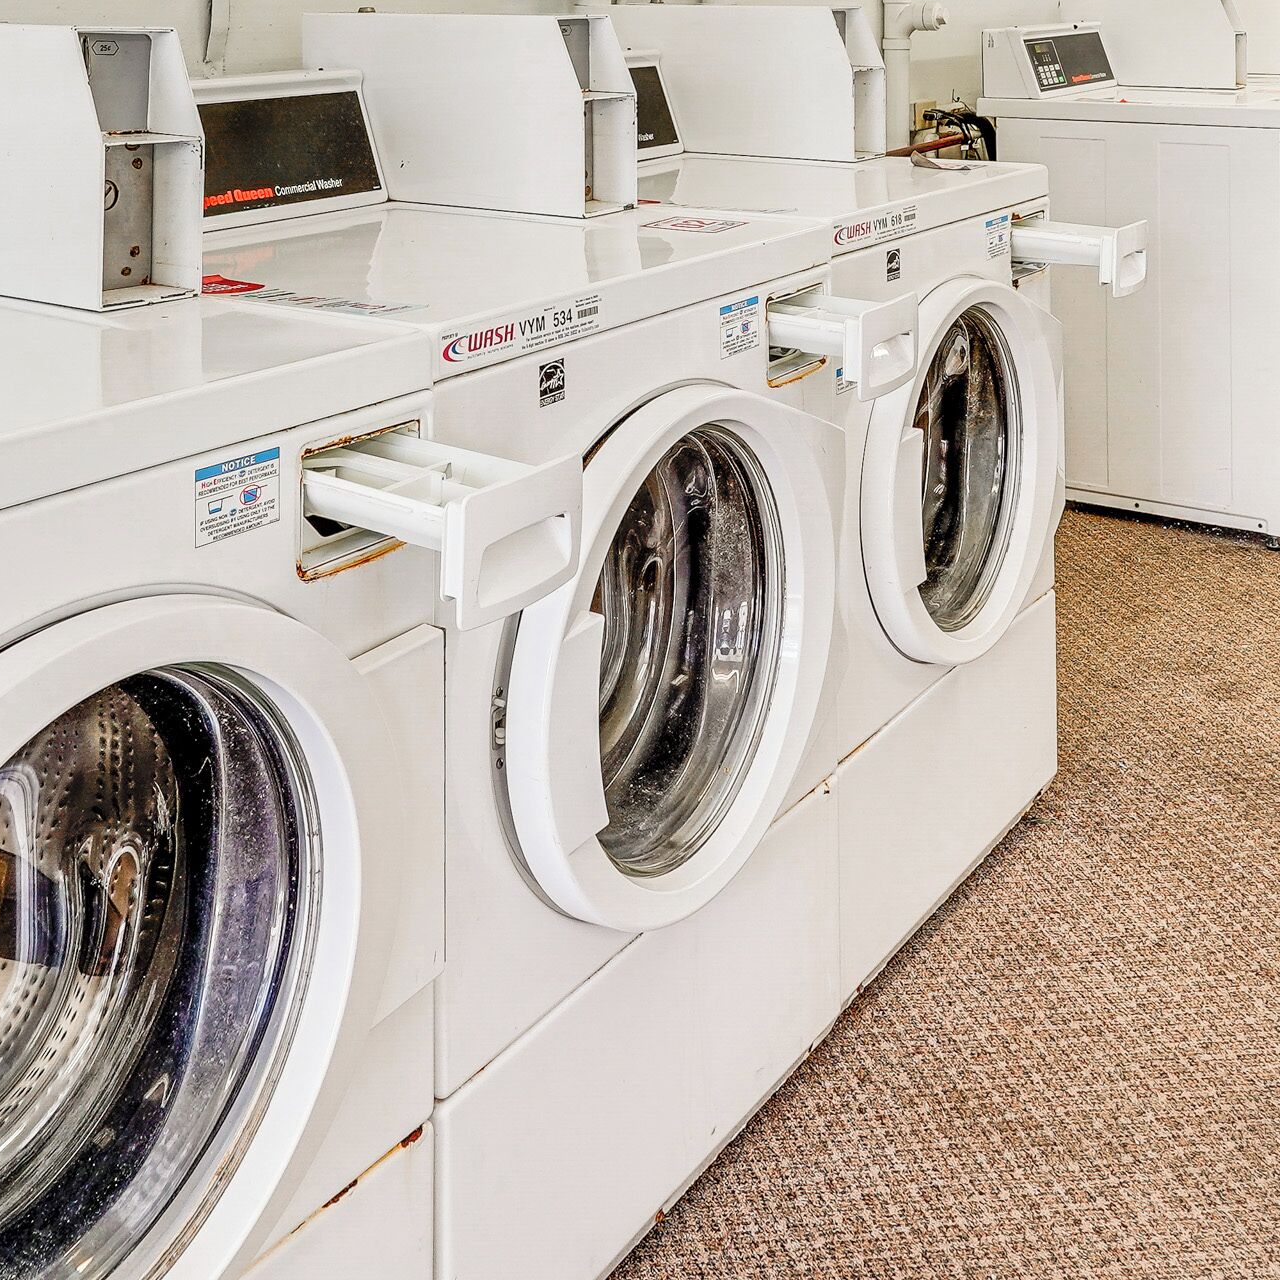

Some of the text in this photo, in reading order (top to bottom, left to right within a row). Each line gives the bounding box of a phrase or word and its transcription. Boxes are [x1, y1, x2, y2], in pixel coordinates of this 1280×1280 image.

[234, 186, 274, 202] Queen
[275, 180, 317, 197] Commercial
[317, 177, 343, 191] Washer
[846, 220, 871, 240] WASH
[873, 217, 888, 232] VYM
[468, 323, 515, 353] WASH
[519, 315, 546, 337] VYM
[553, 308, 573, 328] 534
[221, 455, 257, 473] NOTICE
